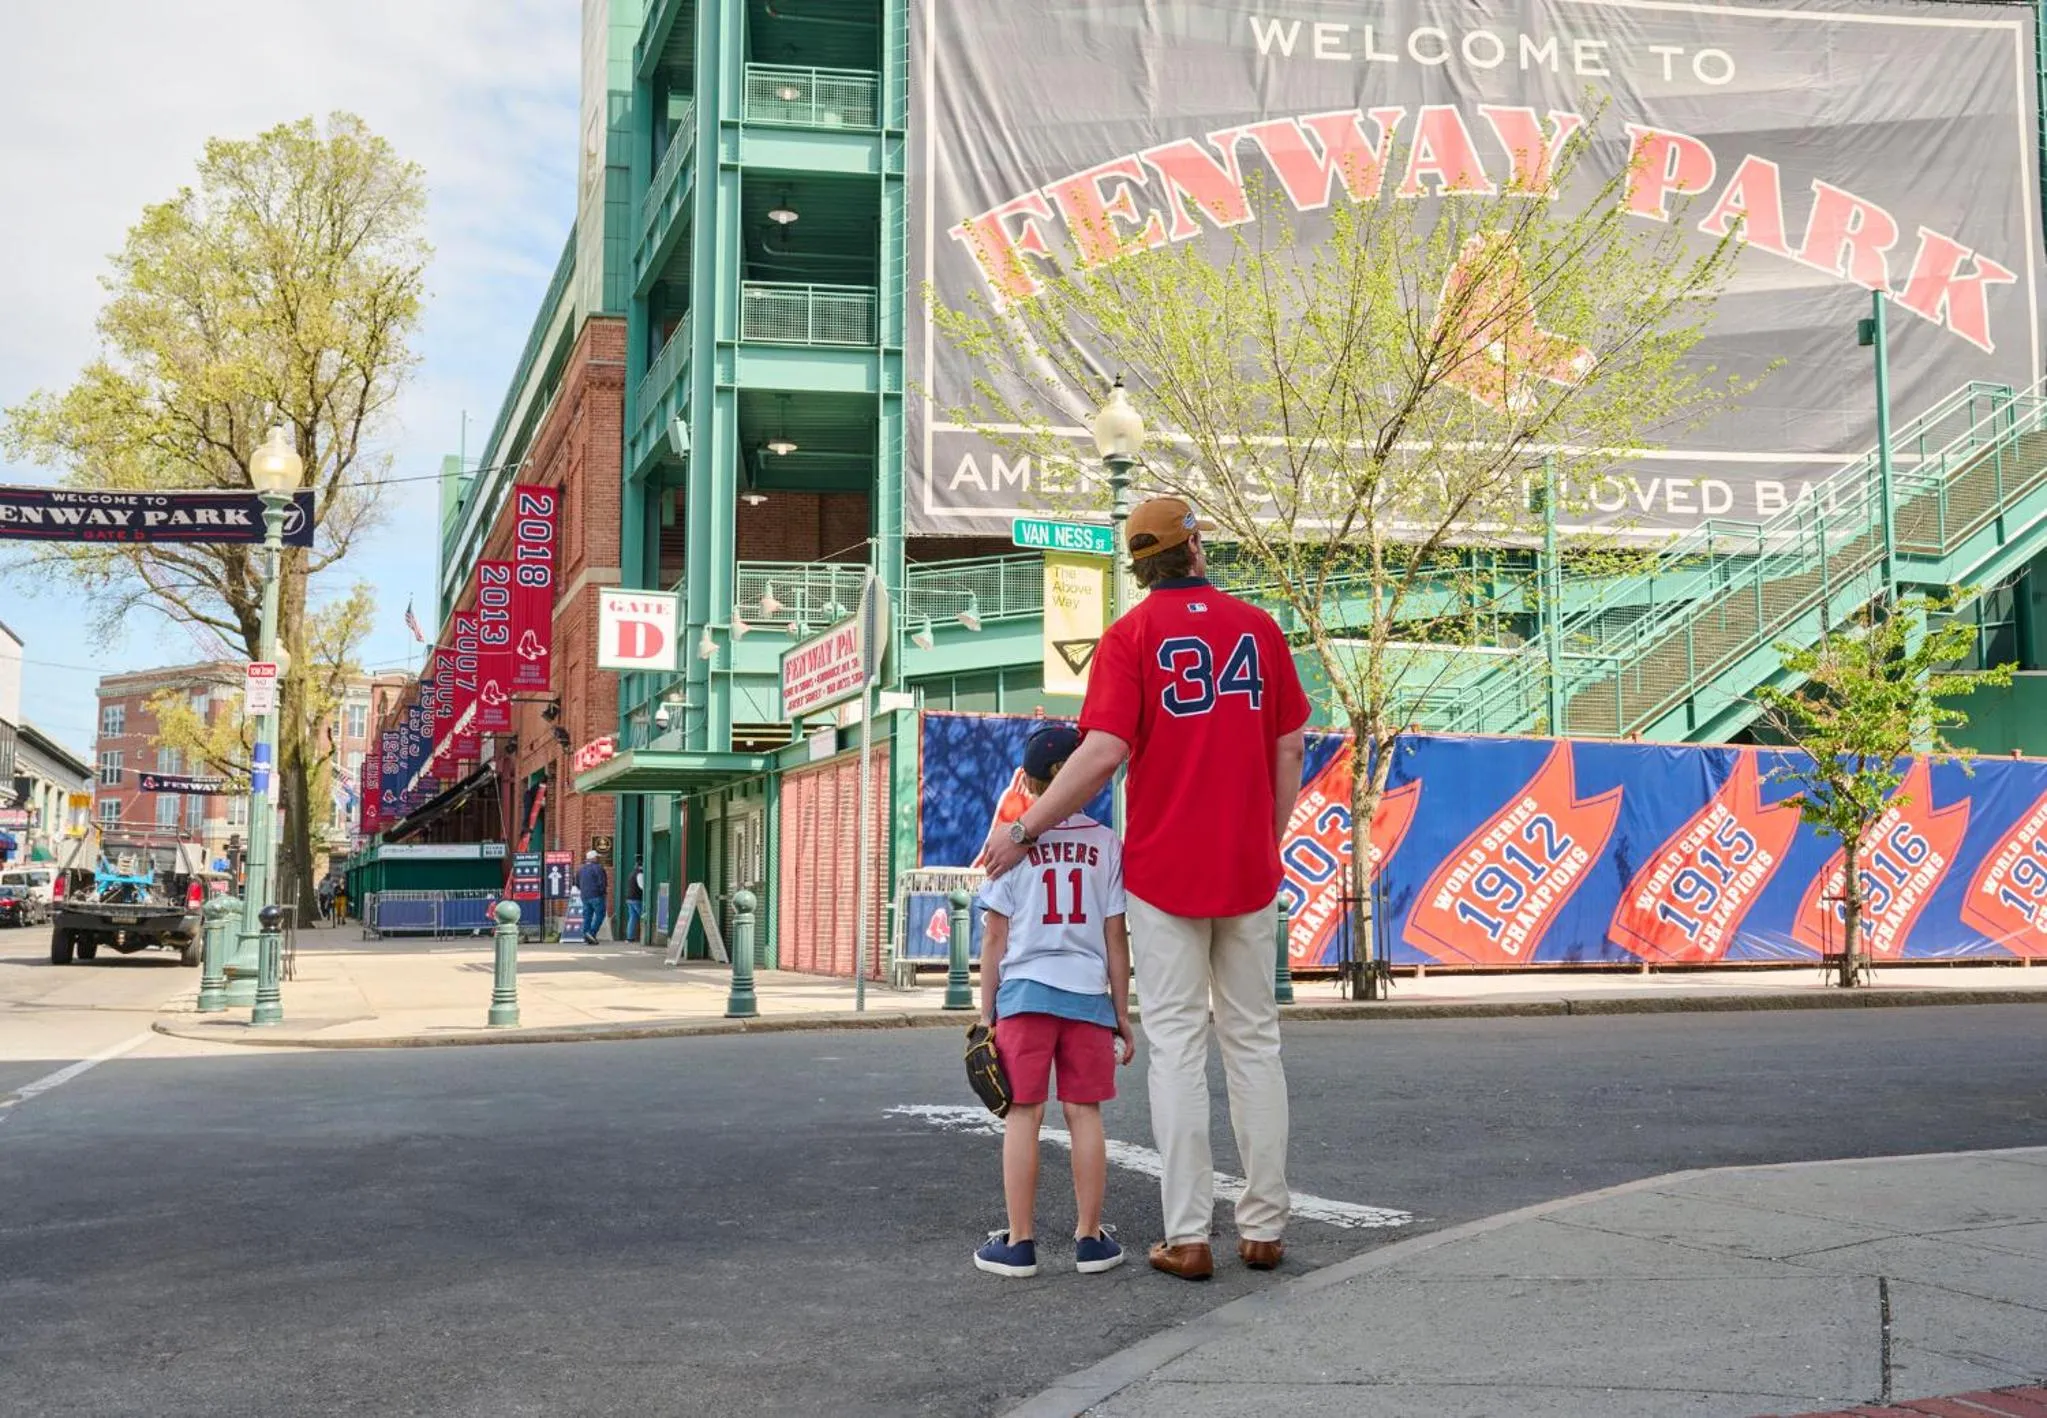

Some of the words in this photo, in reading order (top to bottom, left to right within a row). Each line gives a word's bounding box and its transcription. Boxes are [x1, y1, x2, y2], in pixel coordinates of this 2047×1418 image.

[1249, 16, 1611, 78] WELCOME
[1649, 45, 1735, 86] TO
[947, 103, 1584, 314] FENWAY
[1622, 122, 2018, 354] PARK
[51, 492, 139, 505] WELCOME
[144, 496, 168, 506] TO
[143, 508, 253, 527] PARK
[83, 530, 126, 541] GATE
[134, 530, 145, 541] D
[517, 493, 554, 588] 2018
[1021, 522, 1049, 545] VAN
[1055, 526, 1094, 549] NESS
[1095, 539, 1105, 550] ST
[479, 565, 509, 645] 2013
[1052, 566, 1077, 579] The
[1052, 581, 1092, 595] Above
[1052, 596, 1081, 610] Way
[608, 599, 672, 616] GATE
[614, 619, 665, 659] D
[437, 654, 455, 719] 2004
[456, 617, 478, 692] 2007
[785, 638, 833, 684] FENWAY
[1156, 632, 1264, 718] 34
[1027, 841, 1100, 868] DEVERS
[1432, 847, 1488, 912] WORLD
[1481, 795, 1539, 852] SERIES
[1455, 813, 1575, 942] 1912
[1635, 850, 1685, 912] WORLD
[1679, 802, 1729, 855] SERIES
[1655, 813, 1758, 943] 1915
[1980, 840, 2024, 897] WORLD
[1041, 867, 1088, 925] 11
[1500, 845, 1590, 957] CHAMPIONS
[1698, 848, 1774, 955] CHAMPIONS
[1872, 850, 1946, 953] CHAMPIONS
